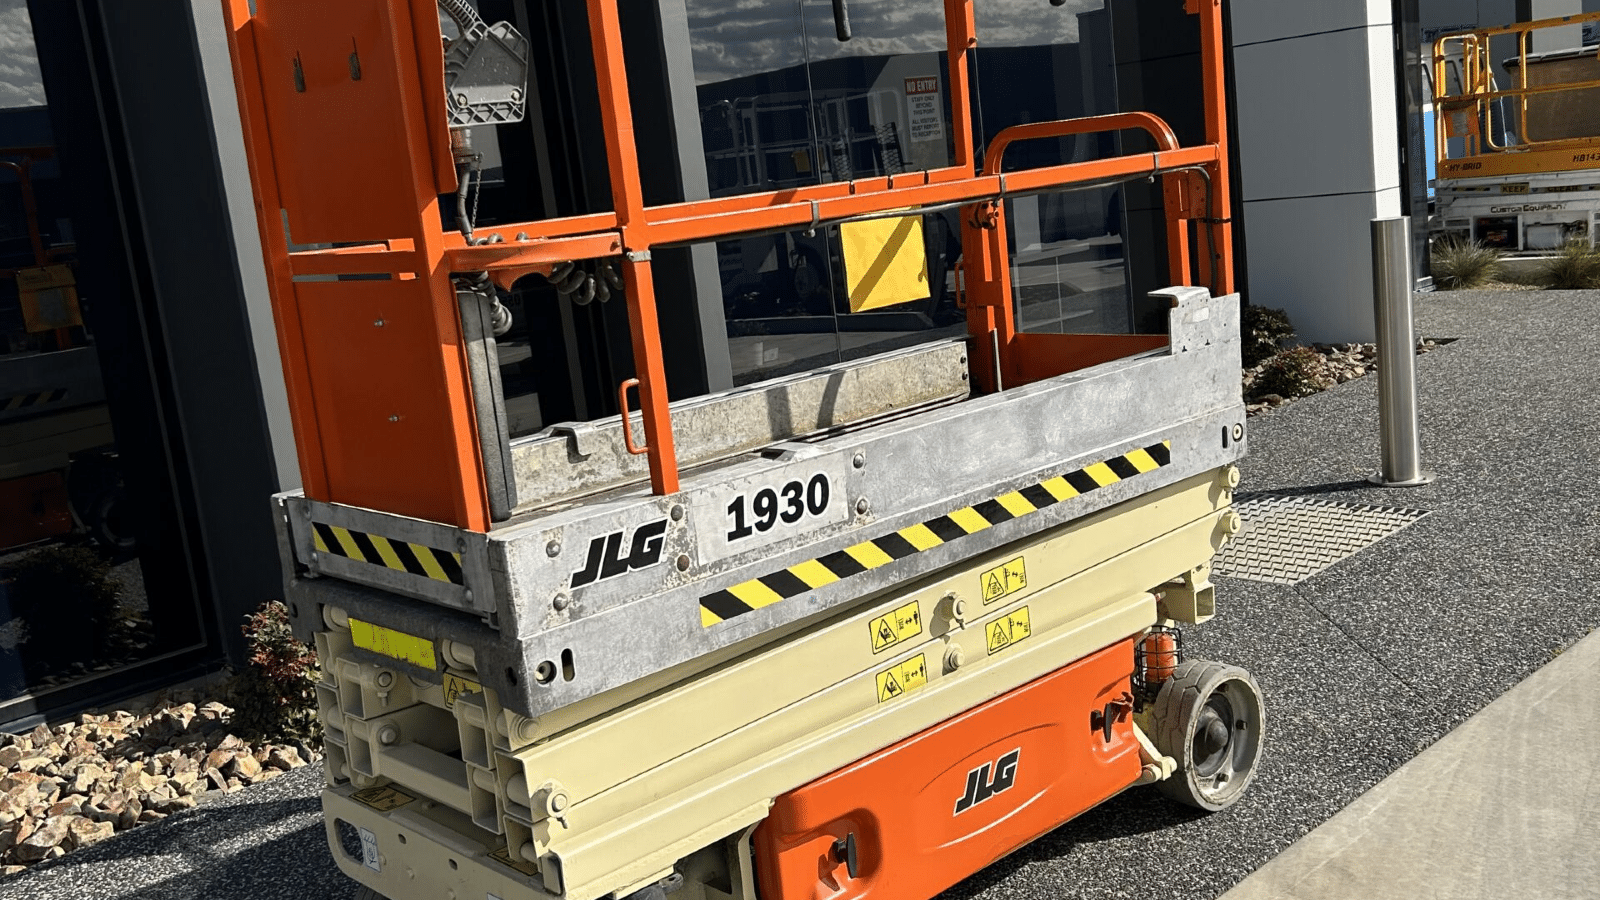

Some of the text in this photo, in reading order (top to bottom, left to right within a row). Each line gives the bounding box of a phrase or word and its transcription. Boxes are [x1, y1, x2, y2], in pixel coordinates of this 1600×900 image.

[907, 79, 937, 93] NO ENTRY
[924, 123, 940, 131] REPORT
[918, 130, 941, 138] RECEPTION
[1449, 162, 1482, 172] HY-BRID
[1502, 184, 1578, 193] KEEP CLEAR
[727, 473, 830, 542] 1930
[570, 519, 668, 588] JLG
[954, 748, 1020, 816] JLG
